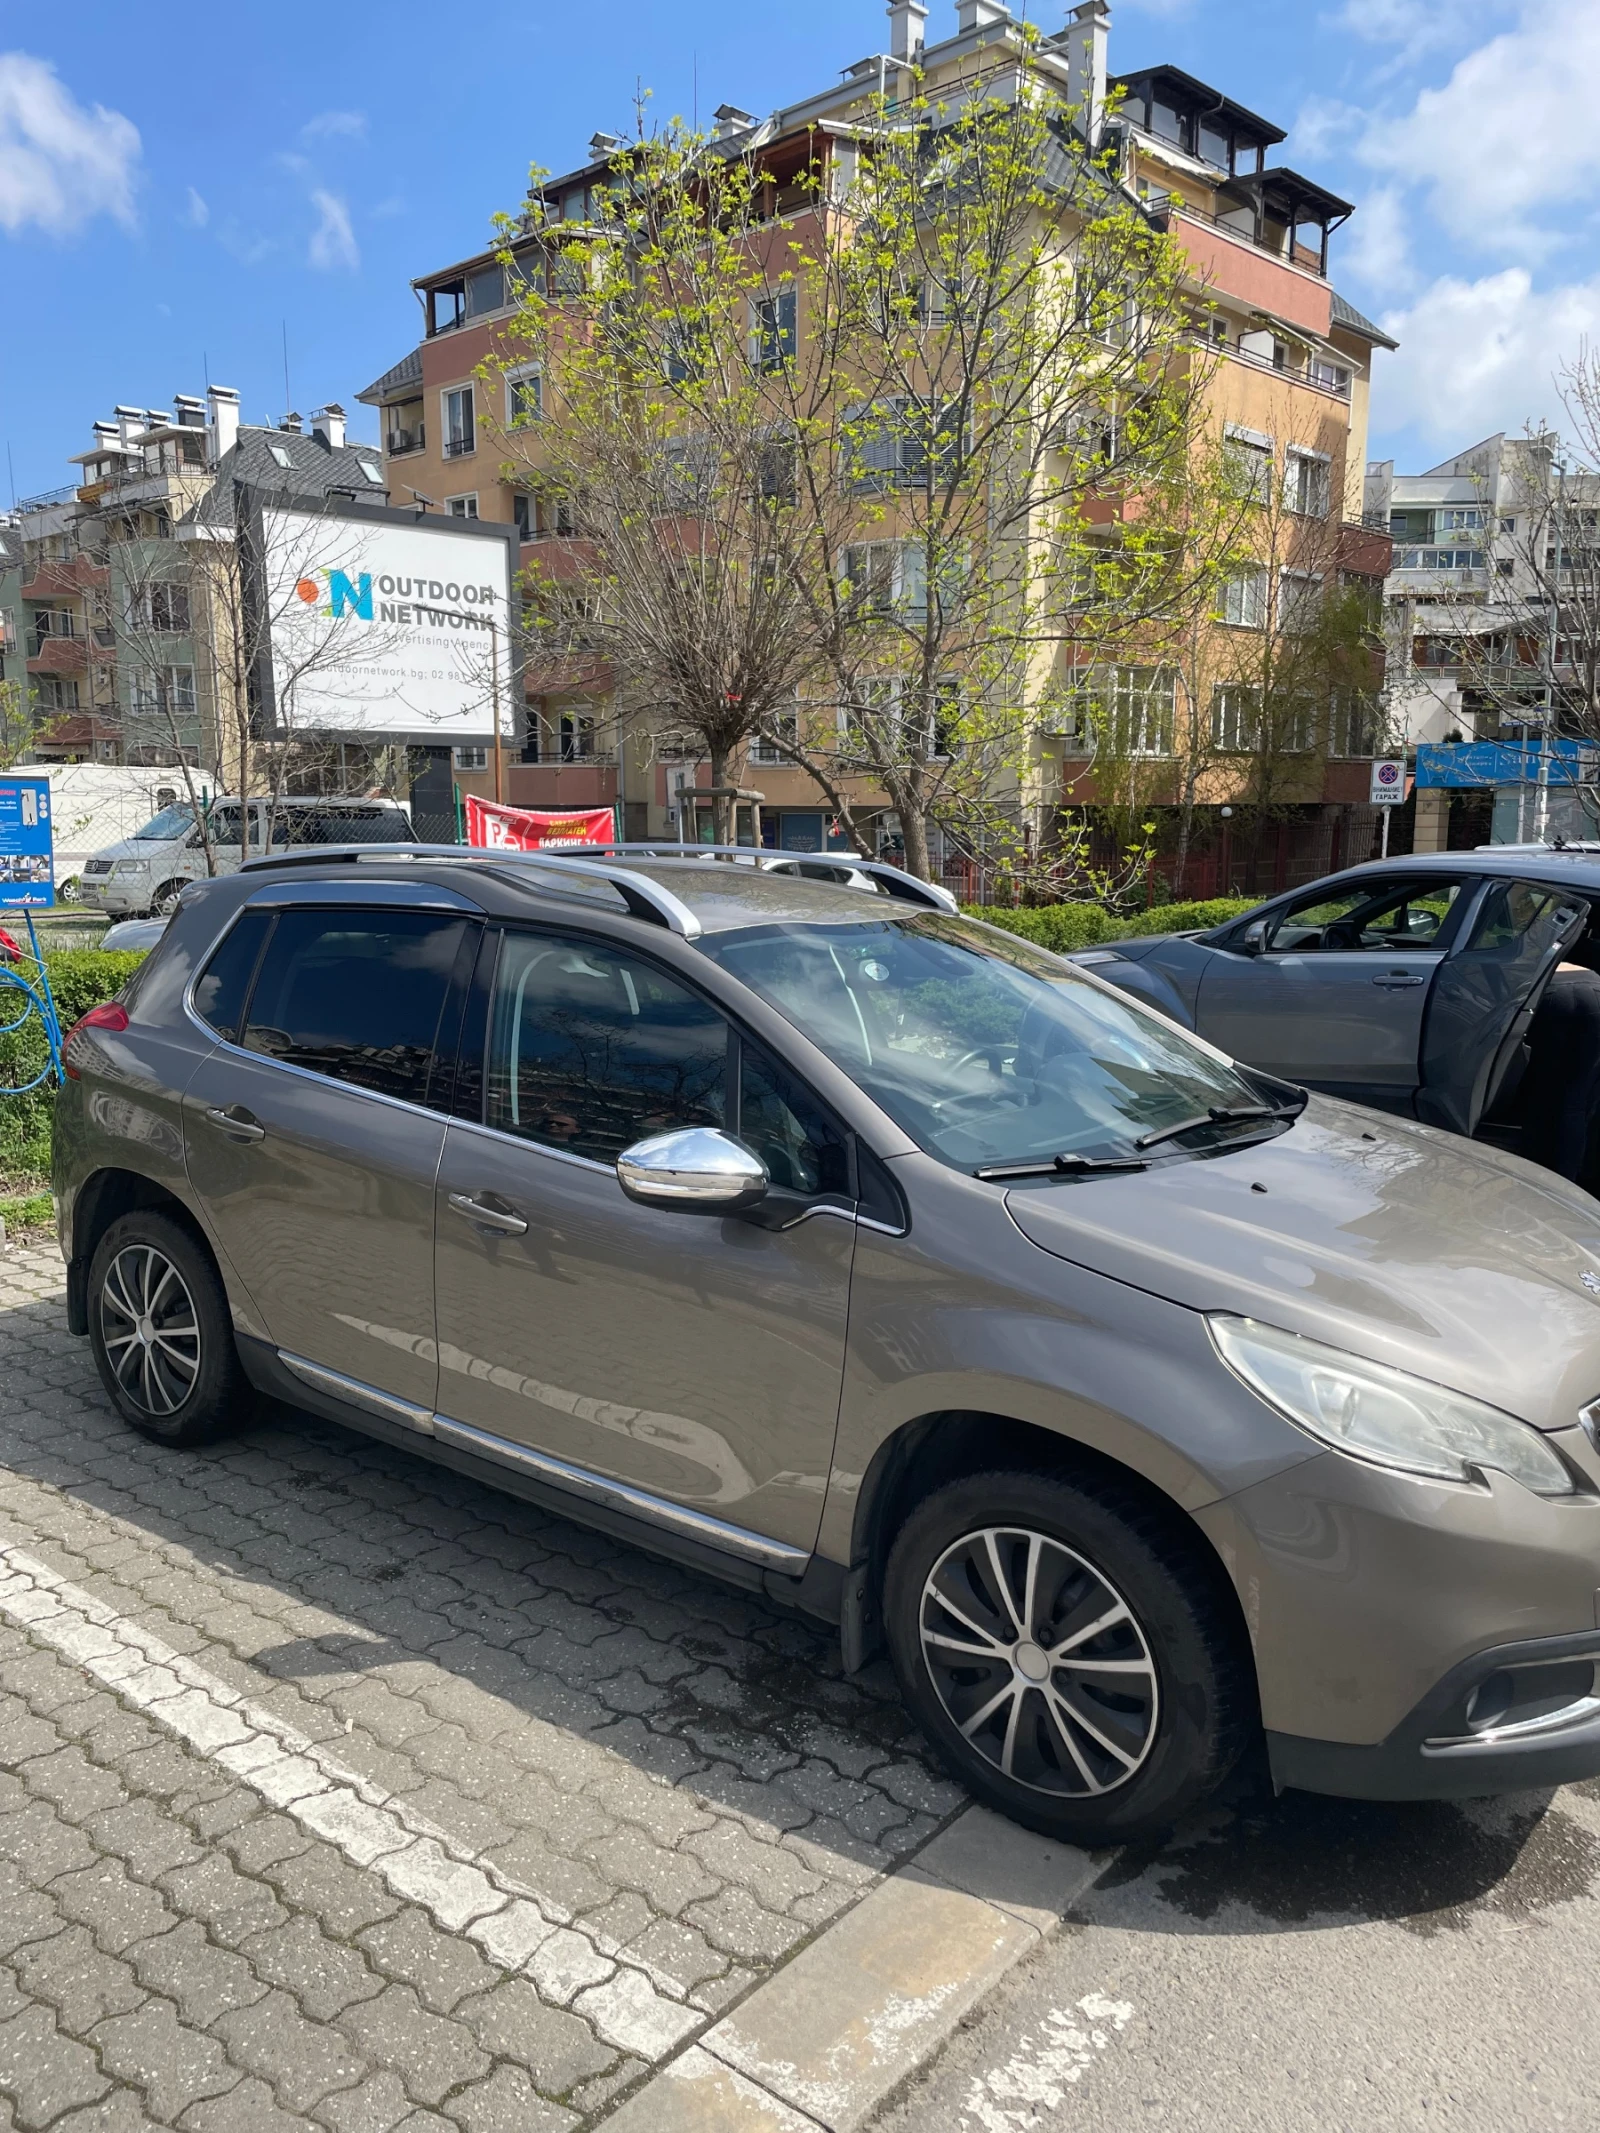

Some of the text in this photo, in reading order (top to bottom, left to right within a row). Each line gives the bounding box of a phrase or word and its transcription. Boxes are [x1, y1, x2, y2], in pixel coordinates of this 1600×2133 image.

[379, 575, 494, 605] OUTDOOR
[380, 602, 494, 631] NETWORK
[383, 631, 449, 649] Advertising
[431, 670, 444, 679] 02
[538, 837, 582, 848] ПАРКИНГ
